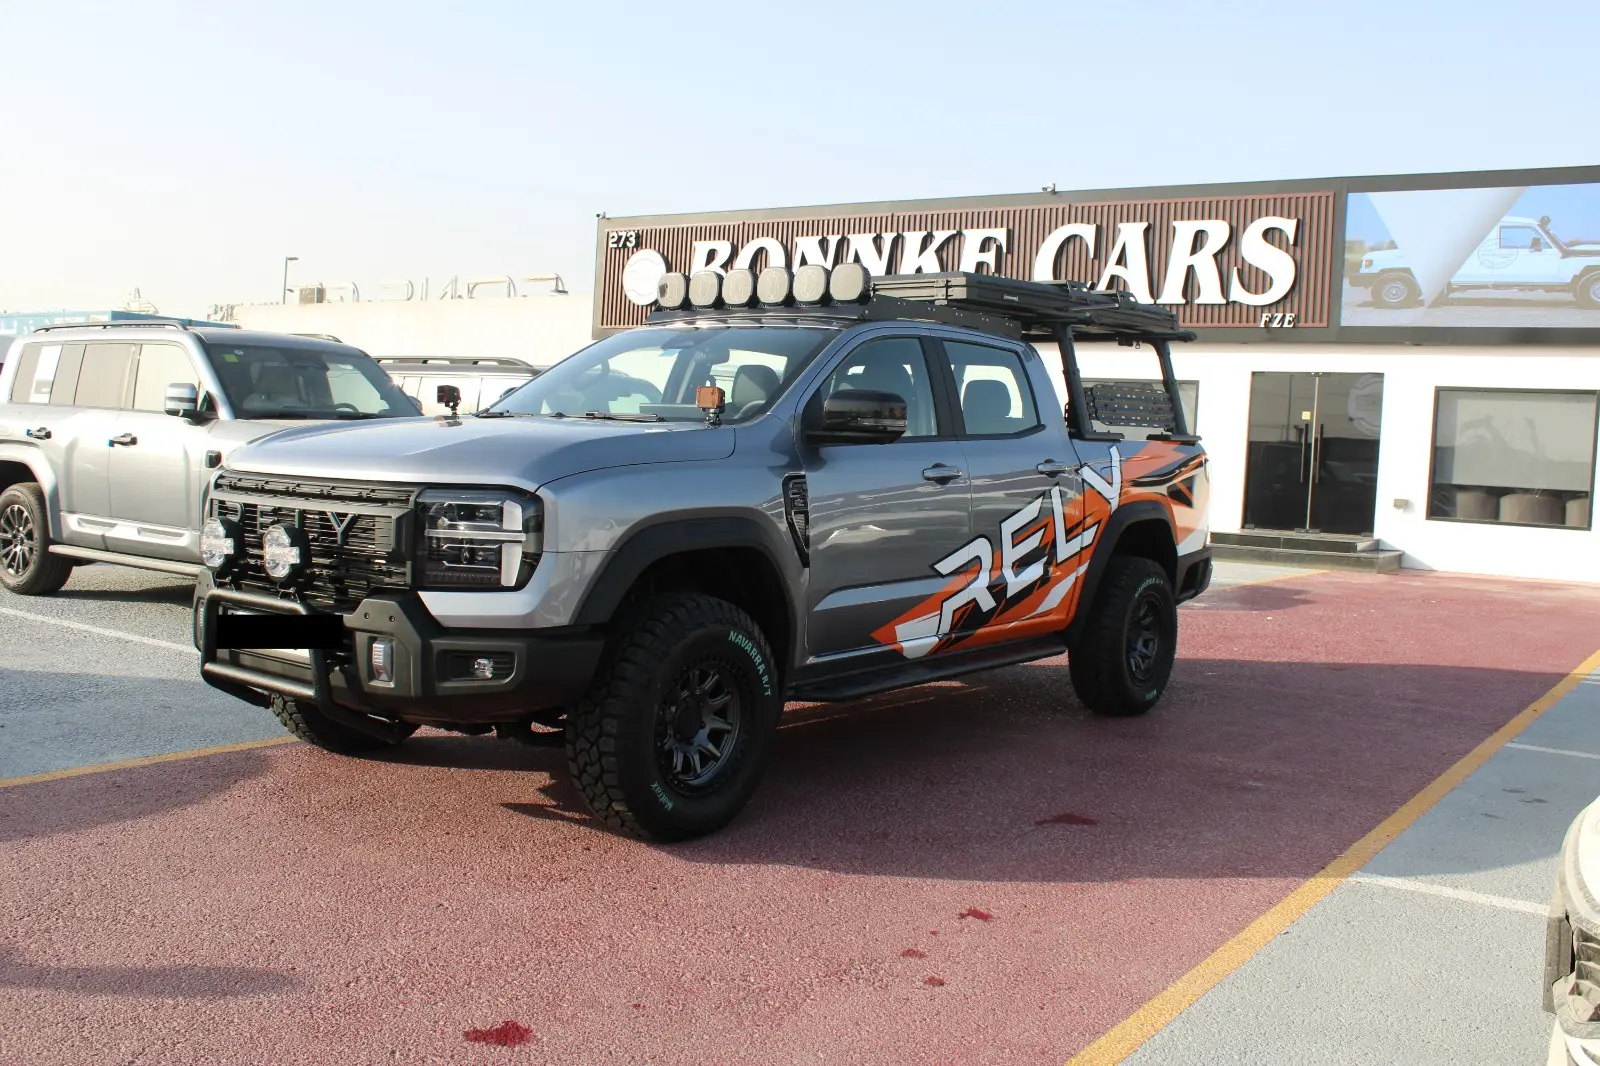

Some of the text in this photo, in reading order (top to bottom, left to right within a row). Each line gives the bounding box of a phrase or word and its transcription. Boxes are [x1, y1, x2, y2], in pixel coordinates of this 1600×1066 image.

[609, 231, 636, 248] 273
[1033, 216, 1299, 306] CARS
[1259, 312, 1296, 328] FZE
[929, 445, 1122, 636] RELY
[728, 630, 767, 675] NAVARRA
